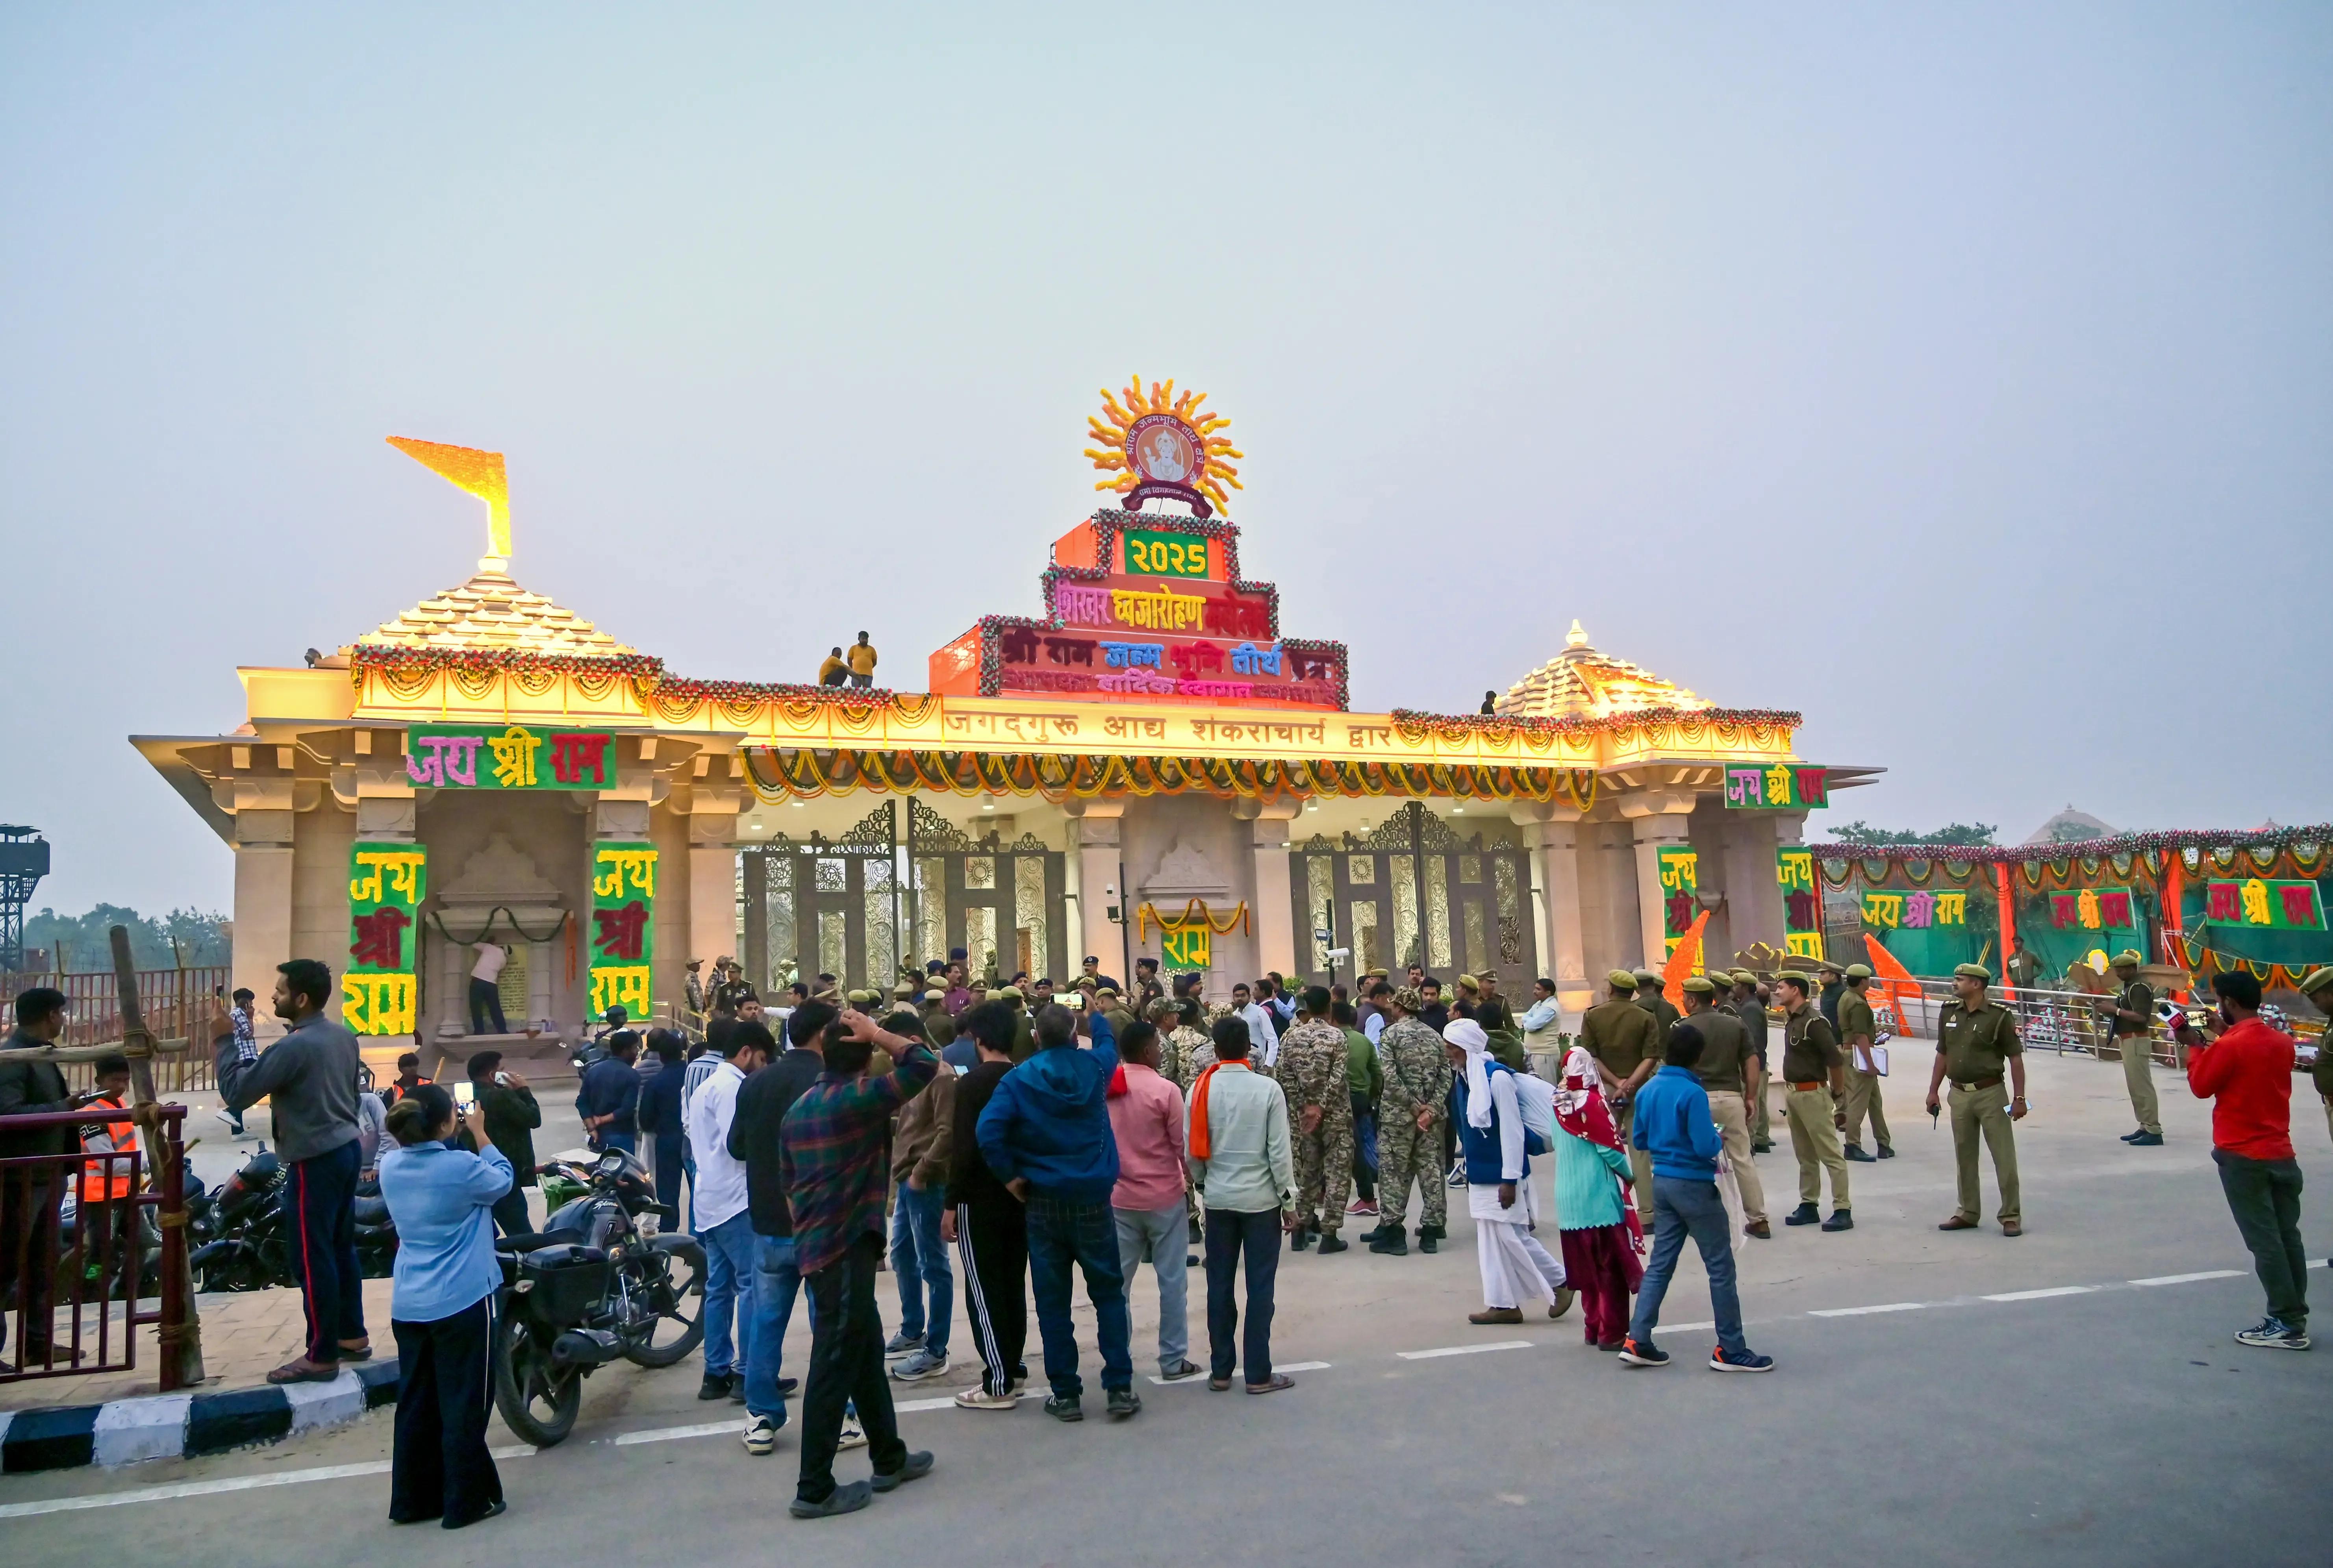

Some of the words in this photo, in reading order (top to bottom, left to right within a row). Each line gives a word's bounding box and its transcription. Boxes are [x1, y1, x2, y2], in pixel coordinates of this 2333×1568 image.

[1043, 636, 1098, 667] राम
[1099, 641, 1164, 669] जन्म
[1170, 641, 1225, 681] भूमि
[1229, 642, 1283, 676] तीर्थ
[1094, 668, 1176, 694] हार्दिक
[1176, 679, 1255, 698] स्वागत
[1103, 716, 1167, 739] आद्य
[1190, 714, 1327, 744] शंकराचार्य
[1347, 725, 1392, 748] द्वार
[406, 736, 484, 787] जय
[487, 726, 542, 787] श्री
[549, 733, 611, 783] राम
[1729, 769, 1762, 805] जय
[1766, 764, 1791, 805] श्री
[1796, 768, 1827, 803] राम
[350, 852, 425, 904] जय
[593, 850, 658, 898] जय
[1661, 853, 1697, 890] जय
[1777, 853, 1814, 888] जय
[1666, 889, 1695, 933] श्री
[1861, 894, 1902, 928] जय
[1902, 890, 1936, 929] श्री
[1936, 893, 1966, 924] राम
[2078, 889, 2101, 929] श्री
[2207, 883, 2241, 922] जय
[2240, 878, 2271, 925] श्री
[349, 906, 411, 968] श्री
[593, 900, 649, 959] श्री
[1164, 924, 1210, 967] राम
[341, 972, 417, 1036] राम
[590, 965, 650, 1016] राम
